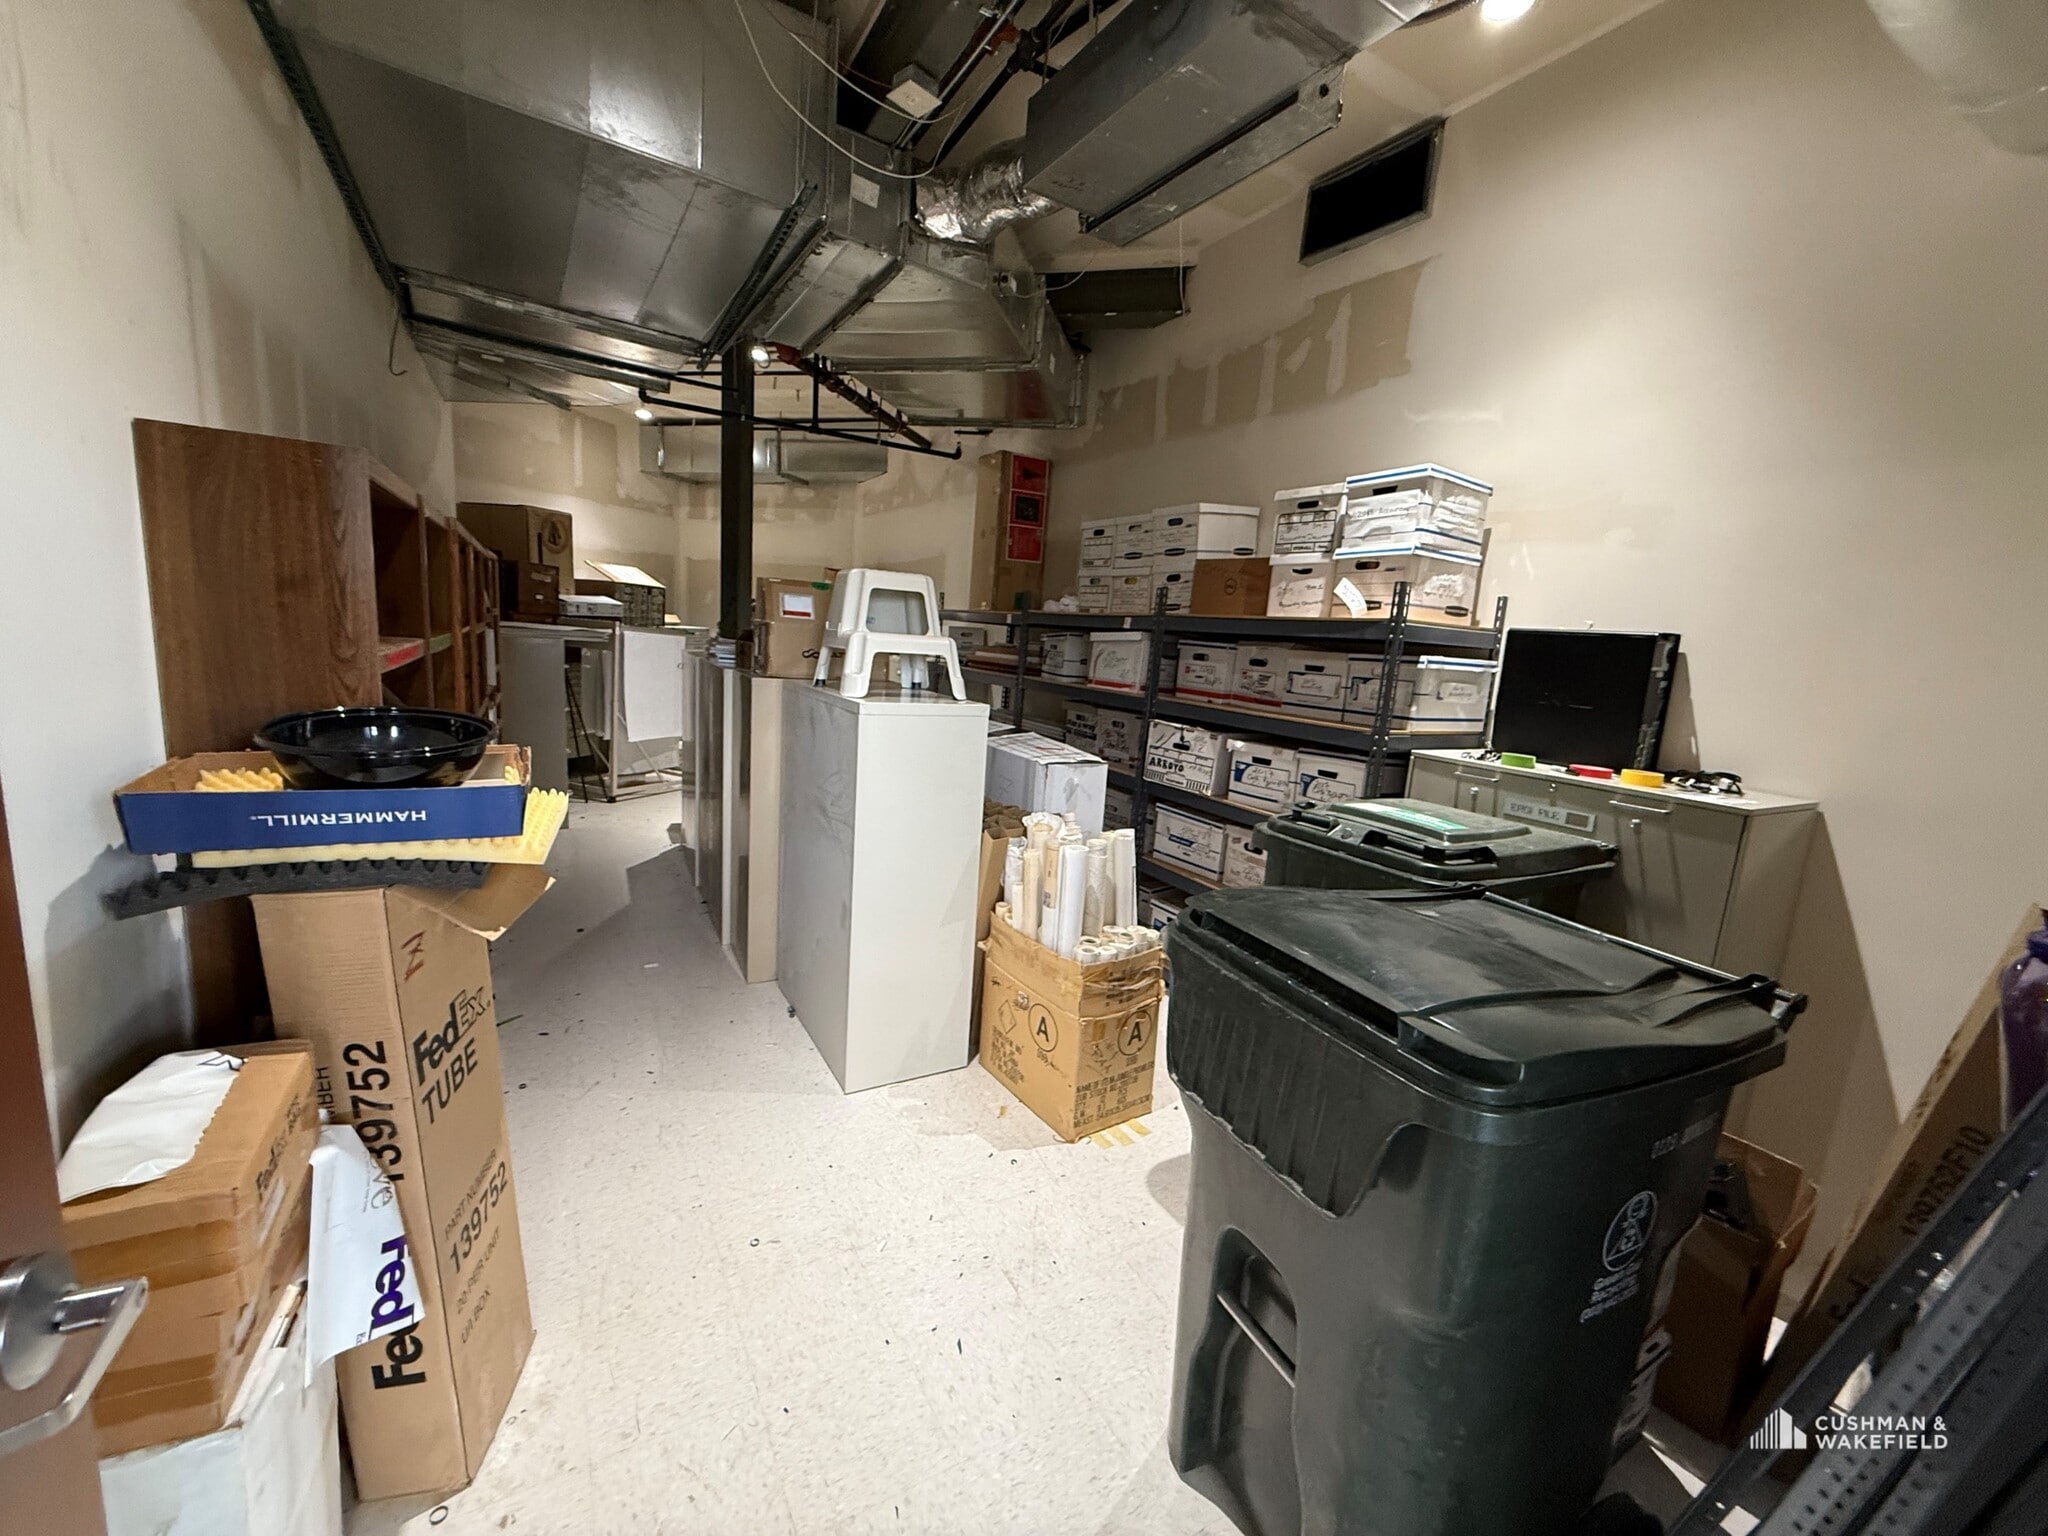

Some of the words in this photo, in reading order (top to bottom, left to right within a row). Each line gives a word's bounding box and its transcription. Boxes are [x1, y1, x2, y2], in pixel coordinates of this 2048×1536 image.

[1148, 756, 1185, 773] ARROYO
[255, 809, 427, 827] HAMMERMILL
[413, 986, 486, 1087] FedEx
[1036, 1016, 1050, 1043] A
[1127, 1022, 1143, 1047] A
[422, 1037, 478, 1125] TUBE
[450, 1160, 508, 1274] 139752
